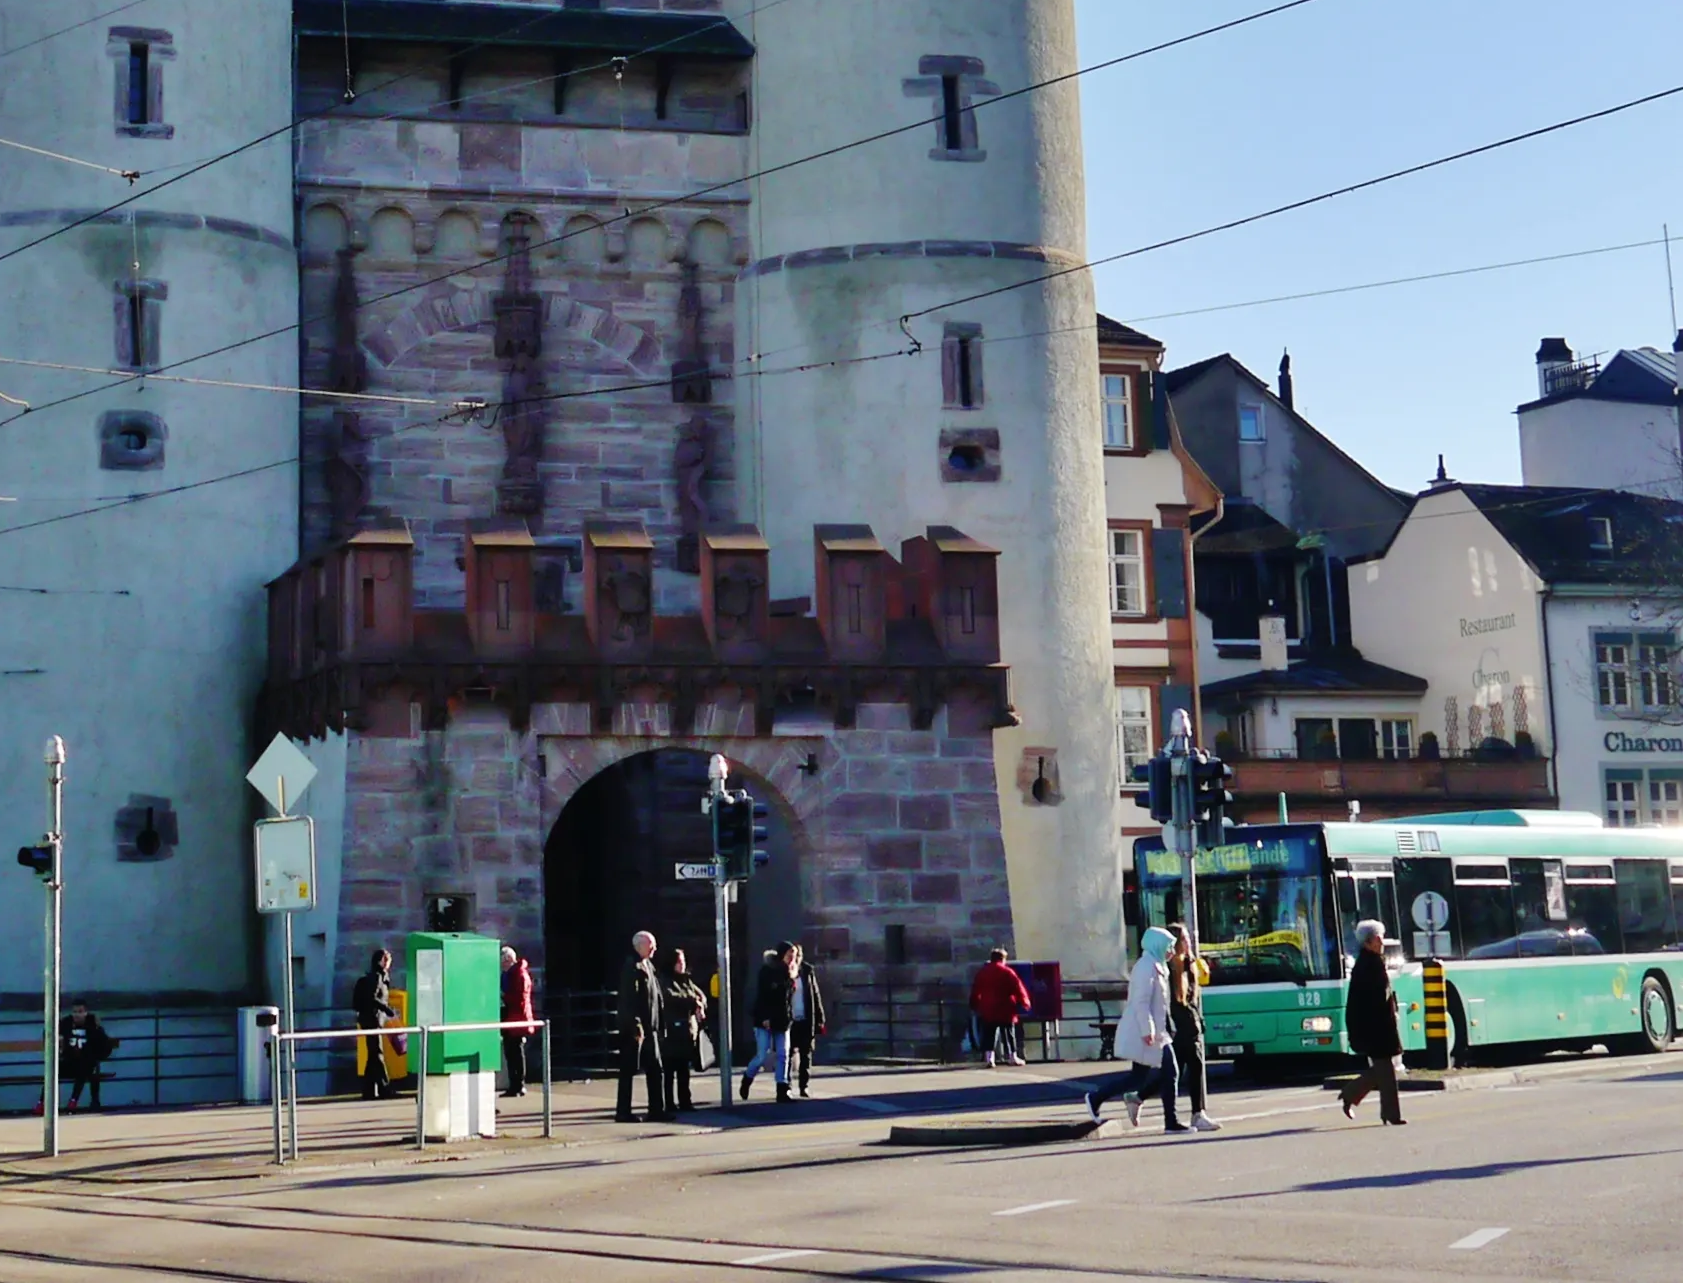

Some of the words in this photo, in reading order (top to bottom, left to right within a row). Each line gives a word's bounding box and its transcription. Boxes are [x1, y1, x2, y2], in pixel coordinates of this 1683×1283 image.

[1460, 612, 1516, 637] Restaurant
[1472, 669, 1510, 689] Charon
[1603, 731, 1683, 753] Charon
